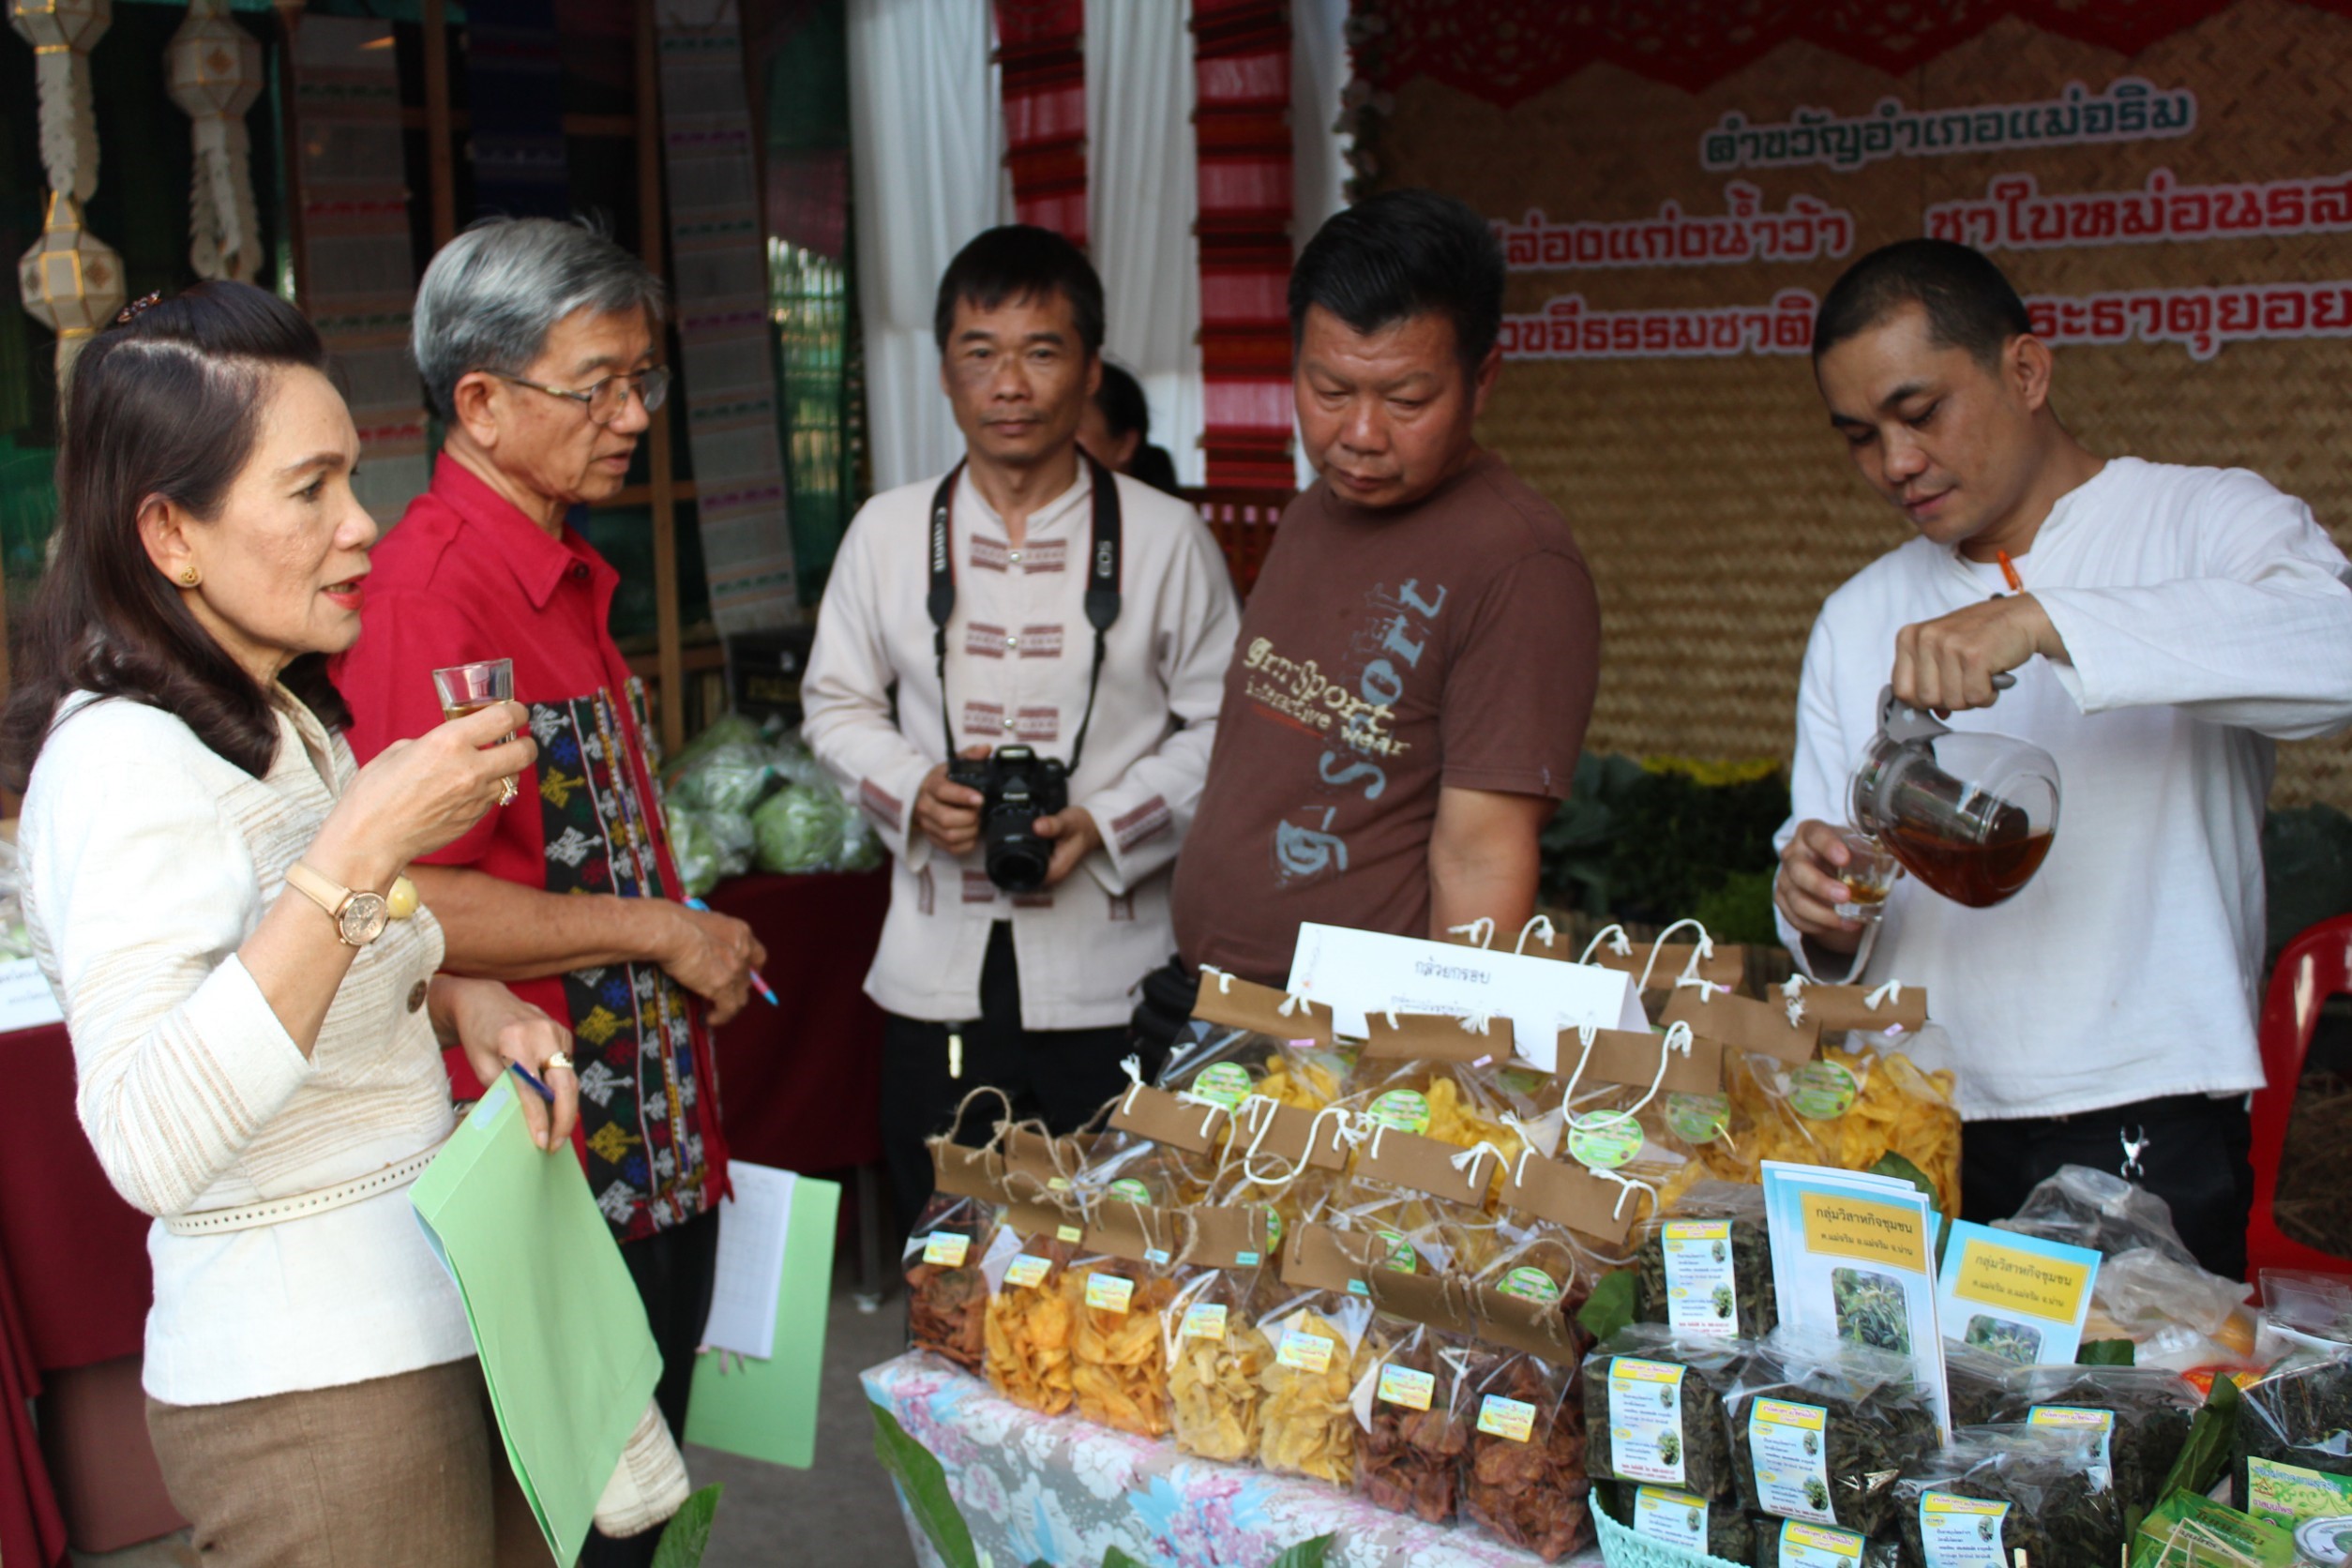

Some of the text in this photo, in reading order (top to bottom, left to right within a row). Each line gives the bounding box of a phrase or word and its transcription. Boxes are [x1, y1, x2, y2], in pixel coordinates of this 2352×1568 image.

[1706, 84, 2189, 163] คำขวัญอำเภอแม่จริม
[1500, 295, 1812, 354] วขจีธรรมชาติ
[2028, 289, 2352, 353] ระธาตุยอย
[934, 506, 948, 573] Canon
[1097, 540, 1113, 579] EOS
[1339, 724, 1412, 758] wear
[1415, 956, 1491, 985] กล้วยกรอบ
[1816, 1206, 1913, 1234] กลุ่มวิสาหกิจชุมชน
[1975, 1255, 2073, 1286] กลุ่มวิสาหกิจชุมชน
[2253, 1499, 2294, 1515] ชาสมุนไพร
